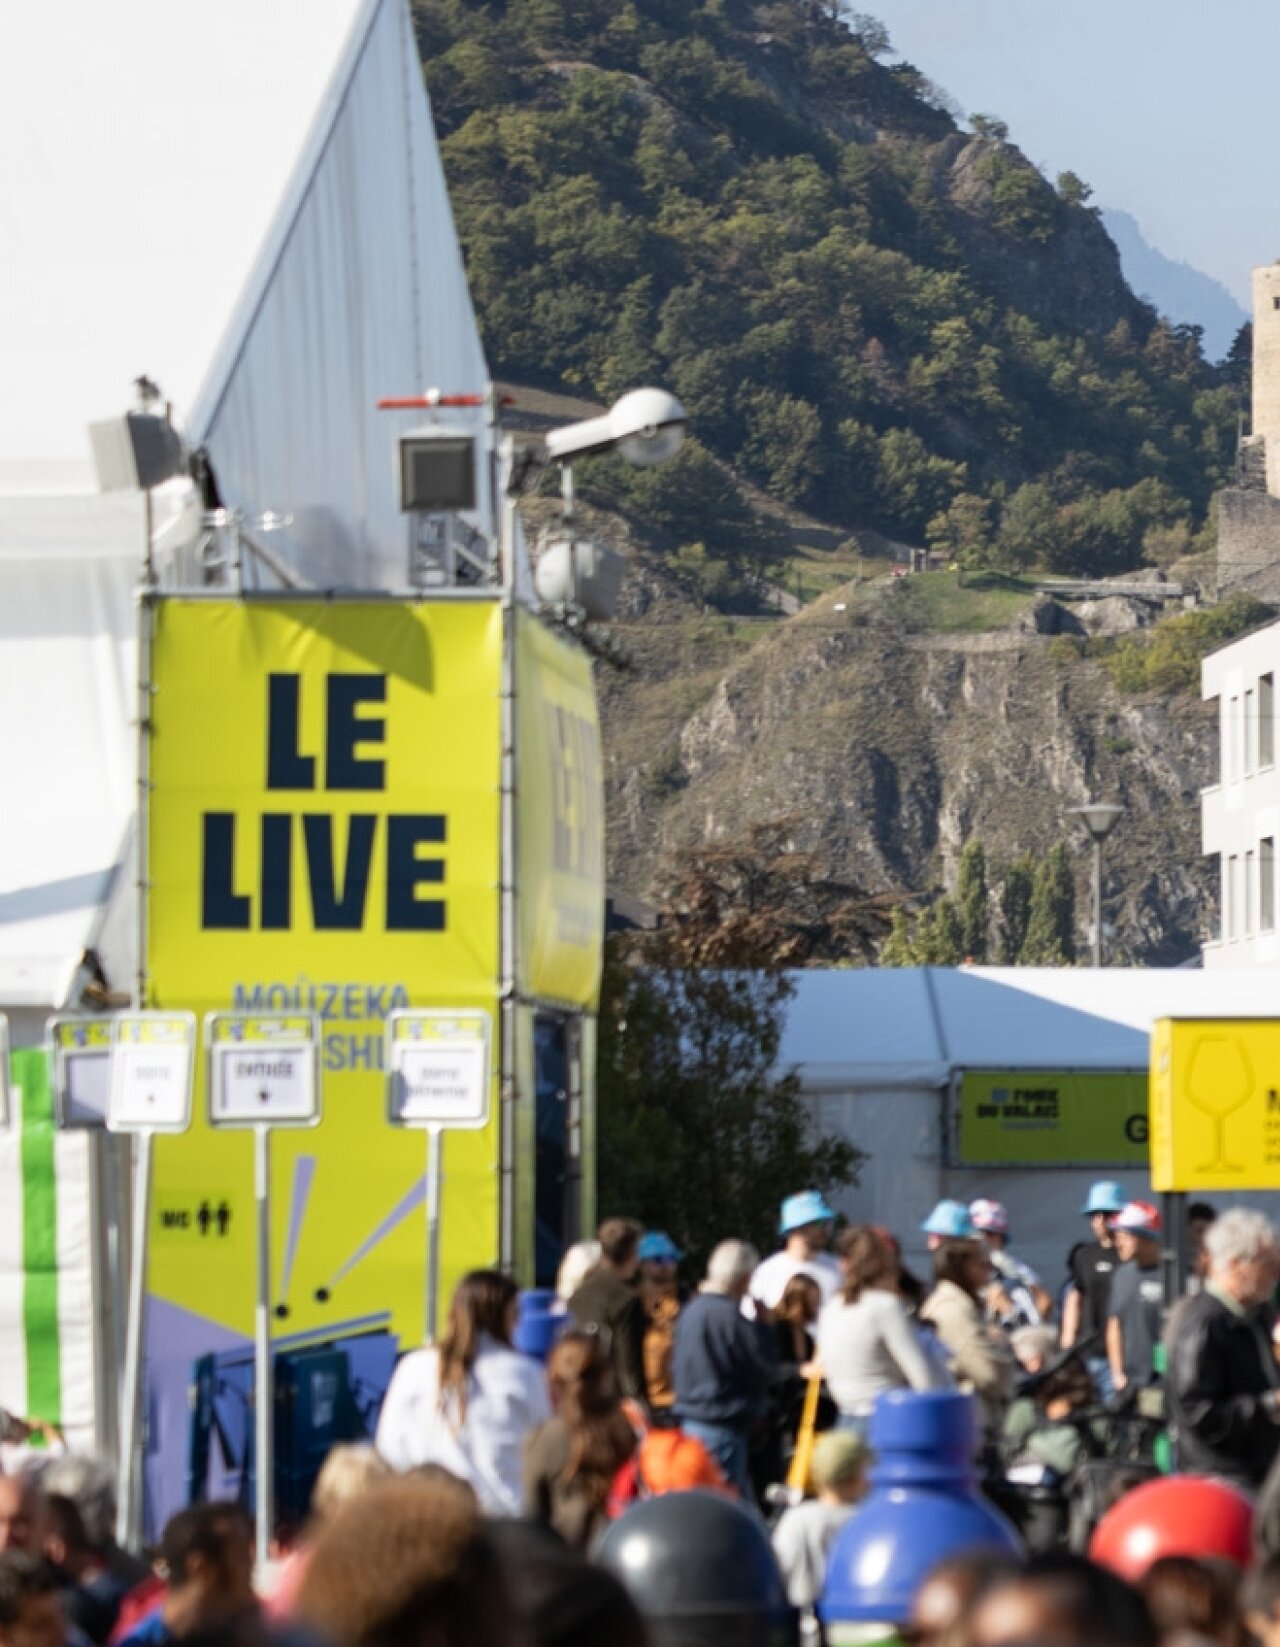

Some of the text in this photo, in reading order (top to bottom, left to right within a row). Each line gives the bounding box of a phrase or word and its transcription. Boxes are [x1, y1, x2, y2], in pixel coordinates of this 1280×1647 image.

[266, 671, 387, 791] LE
[200, 811, 448, 932] LIVE
[162, 1210, 190, 1230] WC
